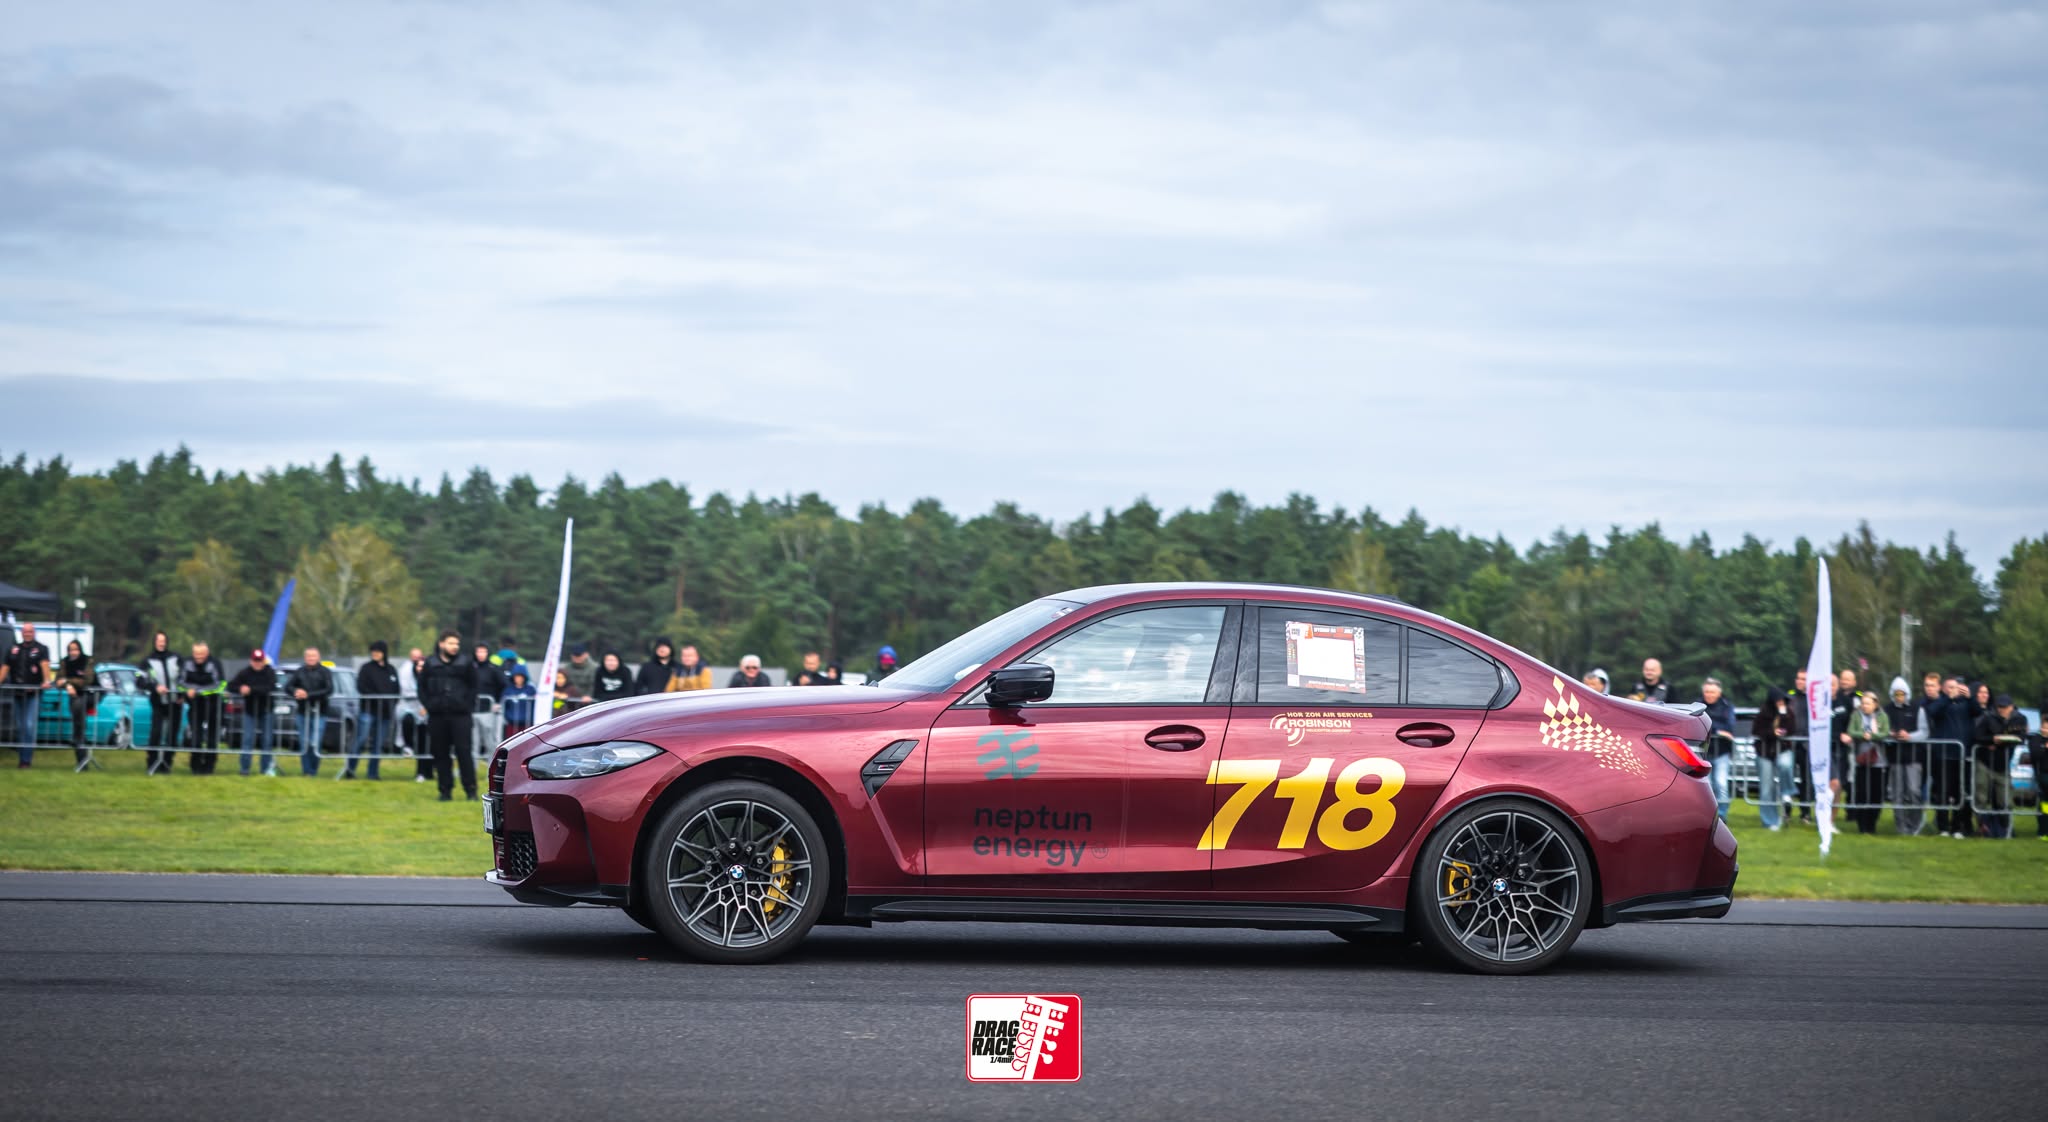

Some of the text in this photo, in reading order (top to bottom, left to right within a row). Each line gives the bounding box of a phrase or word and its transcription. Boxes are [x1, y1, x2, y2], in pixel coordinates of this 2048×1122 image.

[1289, 719, 1352, 728] ROBINSON
[1196, 757, 1406, 851] 718
[974, 805, 1092, 836] neptun
[973, 835, 1087, 867] energy
